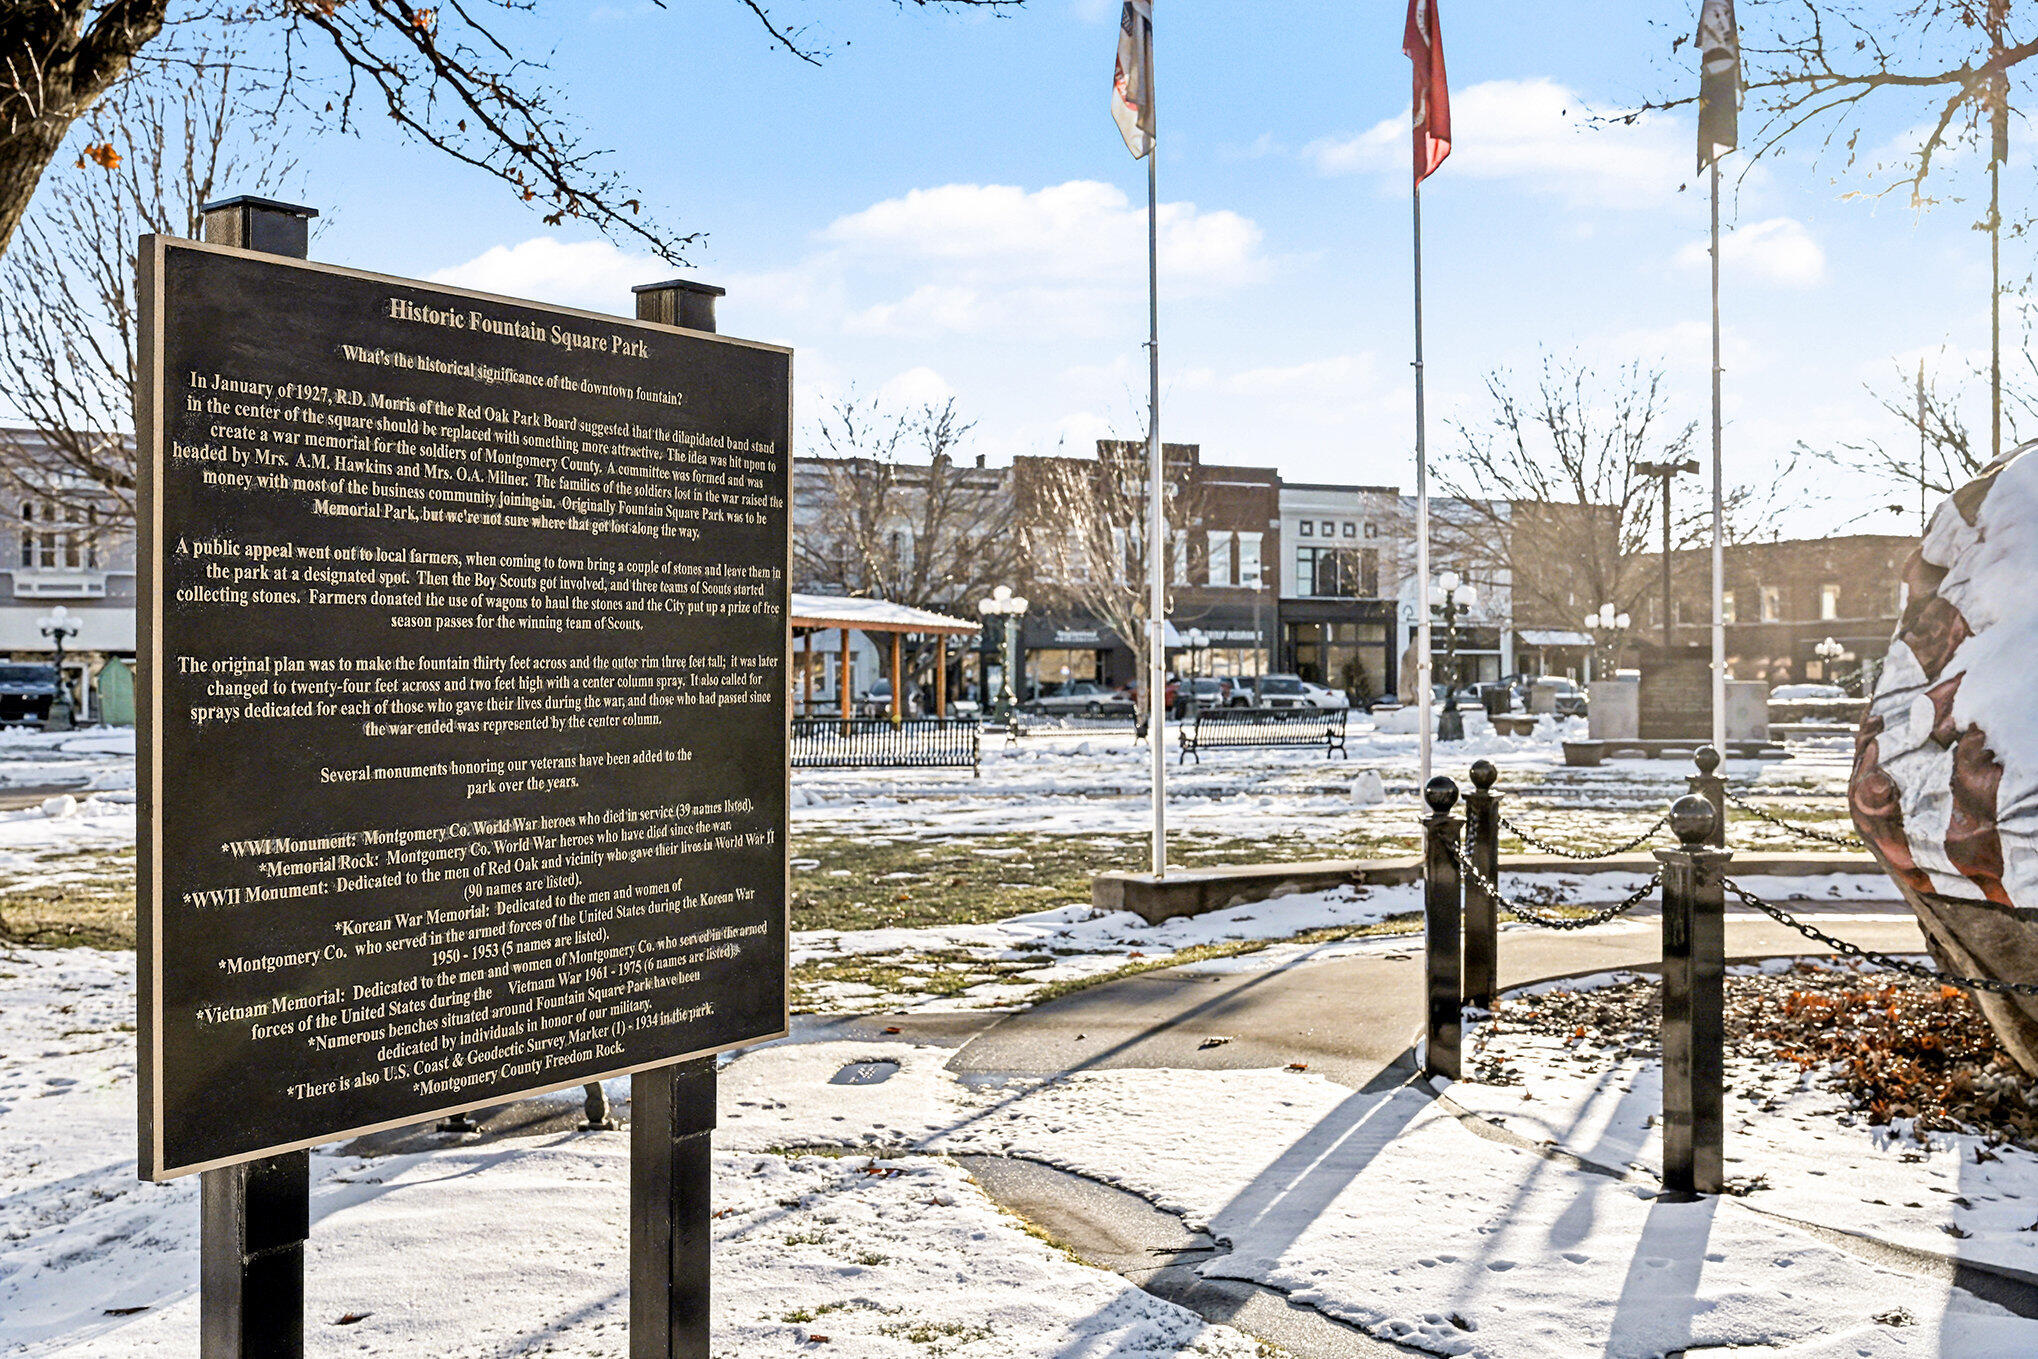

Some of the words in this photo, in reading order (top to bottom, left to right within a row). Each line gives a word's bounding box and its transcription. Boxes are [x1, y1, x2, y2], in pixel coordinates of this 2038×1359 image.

[388, 297, 466, 329] Historic
[468, 310, 546, 342] Fountain
[549, 324, 610, 352] Square
[611, 334, 648, 358] Park
[390, 352, 417, 370] the
[416, 354, 477, 378] historical
[476, 364, 544, 387] significance
[544, 374, 560, 389] of
[560, 376, 580, 392] the
[580, 378, 633, 399] downtown
[635, 386, 682, 406] fountain?
[191, 370, 207, 389] In
[211, 373, 273, 401] January
[275, 382, 296, 399] of
[295, 383, 333, 406] 1927,
[332, 388, 366, 407] R.D.
[367, 392, 416, 413] Morris
[415, 399, 433, 415] of
[432, 400, 454, 417] the
[457, 403, 481, 420] Red
[482, 406, 509, 424] Oak
[512, 409, 541, 427] Park
[543, 413, 577, 431] Board
[577, 421, 629, 438] suggested
[632, 424, 652, 440] that
[652, 427, 670, 442] the
[671, 429, 724, 448] dilapidated
[726, 435, 749, 451] band
[750, 440, 774, 454] stand
[175, 536, 189, 554] A
[192, 538, 241, 559] public
[244, 542, 293, 562] appeal
[294, 546, 332, 560] went
[333, 547, 356, 561] out
[356, 547, 373, 562] to
[374, 546, 406, 563] local
[408, 548, 462, 568] farmers,
[464, 551, 496, 567] when
[497, 553, 541, 572] coming
[542, 556, 555, 569] to
[557, 557, 584, 570] town
[586, 556, 616, 575] bring
[617, 561, 624, 572] a
[626, 559, 659, 577] couple
[661, 560, 672, 574] of
[673, 562, 702, 575] stones
[704, 563, 722, 576] and
[723, 563, 747, 577] leave
[748, 564, 770, 578] them
[772, 565, 781, 579] in
[390, 616, 432, 628] season
[433, 616, 474, 632] passes
[476, 614, 495, 628] for
[495, 614, 515, 628] the
[516, 614, 563, 633] winning
[565, 616, 592, 629] team
[593, 616, 607, 629] of
[606, 616, 643, 630] Scouts.
[177, 656, 208, 673] The
[211, 656, 271, 677] original
[273, 656, 305, 676] plan
[308, 659, 335, 672] was
[338, 657, 352, 671] to
[355, 655, 392, 671] make
[392, 655, 415, 671] the
[418, 655, 470, 671] fountain
[472, 655, 507, 673] thirty
[509, 655, 531, 670] feet
[532, 658, 567, 669] across
[569, 655, 590, 669] and
[592, 655, 609, 669] the
[611, 656, 639, 669] outer
[640, 655, 659, 668] rim
[661, 654, 686, 668] three
[688, 654, 705, 668] feet
[707, 654, 726, 670] tall;
[730, 654, 738, 667] it
[739, 657, 756, 667] was
[758, 654, 778, 667] later
[206, 679, 268, 700] changed
[273, 680, 287, 695] to
[290, 678, 371, 698] twenty-four
[374, 677, 399, 693] feet
[401, 680, 441, 692] across
[443, 676, 466, 691] and
[468, 677, 491, 691] two
[494, 676, 515, 690] feet
[518, 675, 543, 693] high
[545, 675, 570, 689] with
[571, 678, 579, 689] a
[581, 676, 615, 688] center
[616, 674, 653, 688] column
[656, 676, 686, 690] spray.
[690, 673, 698, 686] It
[698, 673, 719, 686] also
[720, 672, 747, 686] called
[749, 672, 762, 685] for
[320, 765, 371, 784] Several
[370, 763, 448, 780] monuments
[448, 758, 505, 776] honoring
[507, 760, 528, 772] our
[529, 756, 576, 770] veterans
[578, 753, 604, 767] have
[632, 748, 663, 764] added
[663, 749, 675, 762] to
[675, 747, 692, 761] the
[467, 778, 496, 799] park
[498, 780, 524, 793] over
[526, 775, 545, 790] the
[546, 776, 579, 793] years.
[395, 912, 423, 929] War
[424, 902, 490, 925] Memorial:
[498, 894, 552, 915] Dedicated
[554, 895, 566, 908] to
[568, 890, 586, 906] the
[588, 890, 610, 903] men
[613, 884, 632, 900] and
[634, 882, 670, 897] women
[671, 877, 682, 892] of
[431, 948, 460, 967] 1950
[472, 942, 499, 961] 1953
[501, 940, 513, 955] (5
[515, 938, 551, 954] names
[554, 935, 572, 948] are
[574, 926, 609, 945] listed).
[388, 1016, 438, 1038] benches
[441, 1005, 489, 1028] situated
[491, 997, 533, 1019] around
[536, 989, 585, 1011] Fountain
[587, 984, 625, 1004] Square
[626, 976, 653, 994] Park
[653, 974, 679, 989] have
[377, 1036, 438, 1062] dedicated
[441, 1033, 456, 1052] by
[460, 1020, 524, 1046] individuals
[526, 1018, 537, 1033] in
[540, 1013, 573, 1030] honor
[575, 1007, 587, 1023] of
[588, 1007, 607, 1020] our
[610, 999, 652, 1016] military.
[498, 1059, 542, 1079] County
[545, 1049, 593, 1069] Freedom
[595, 1039, 625, 1058] Rock.
